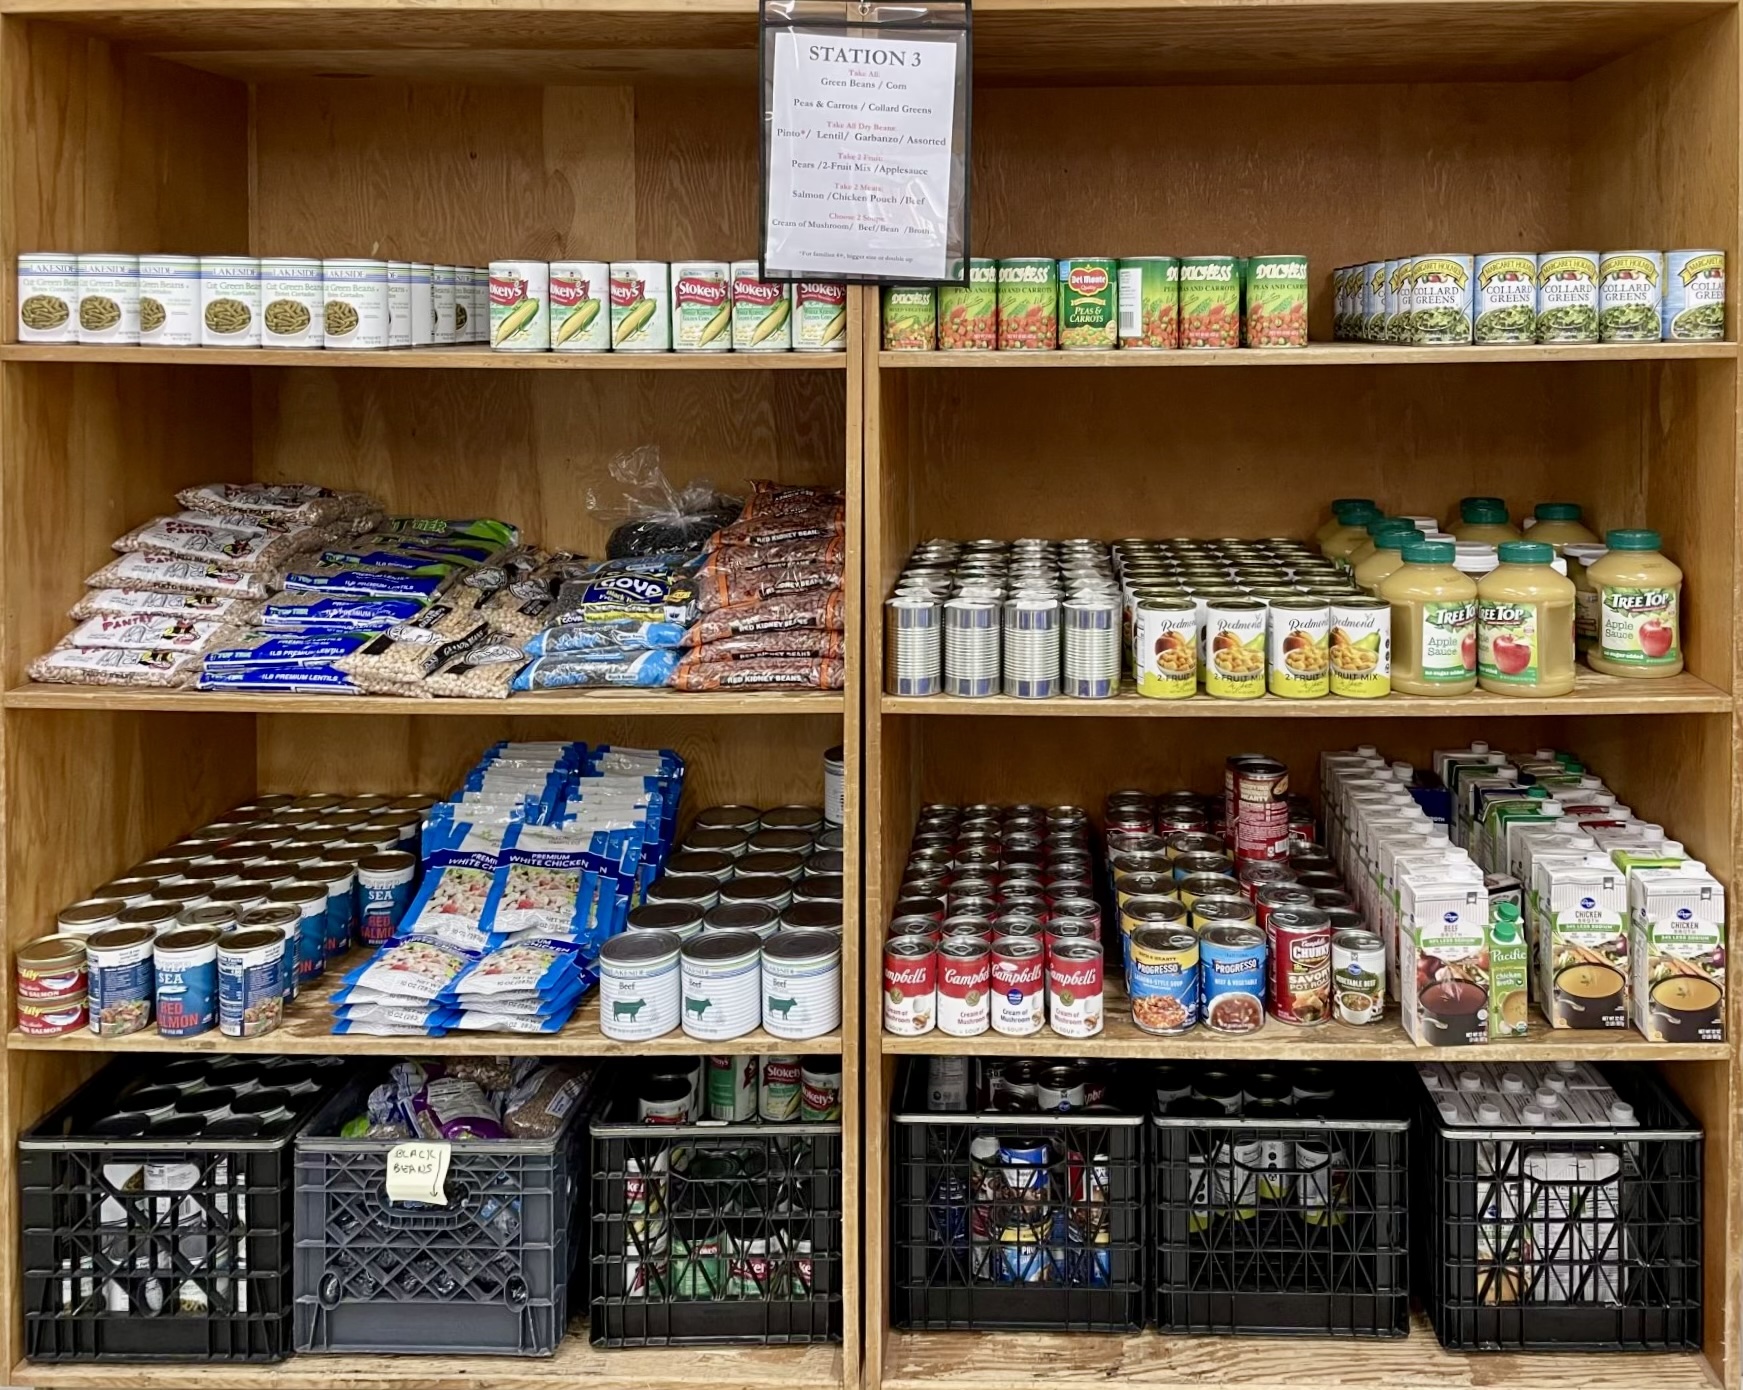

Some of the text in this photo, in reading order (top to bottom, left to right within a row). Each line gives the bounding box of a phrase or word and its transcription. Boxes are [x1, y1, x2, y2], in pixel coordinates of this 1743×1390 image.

[809, 45, 921, 68] STATION 3
[821, 77, 846, 87] Green
[849, 78, 875, 89] Beans
[886, 81, 907, 90] Corn
[794, 98, 813, 107] Peas
[816, 99, 824, 108] &
[826, 101, 858, 111] Carrots
[868, 102, 899, 113] Collard
[902, 105, 932, 115] Greens
[907, 135, 946, 146] Assorted
[791, 160, 815, 169] Pears
[854, 162, 872, 172] Mix
[792, 190, 825, 200] Salmon
[870, 193, 897, 204] Pouch
[772, 218, 797, 228] Cream
[799, 218, 807, 228] of
[1070, 275, 1106, 284] Del Monte
[1485, 285, 1534, 296] COLLARD
[1543, 284, 1592, 295] COLLARD
[1601, 283, 1651, 294] COLLARD
[1416, 296, 1456, 305] GREENS
[1489, 295, 1531, 304] GREENS
[1548, 294, 1590, 304] GREENS
[1605, 292, 1647, 302] GREENS
[1074, 306, 1102, 316] PEAS &
[1068, 313, 1104, 323] CARROTS
[601, 577, 663, 598] GOYA
[1611, 591, 1669, 609] TREE TOP
[1437, 608, 1465, 625] TREE
[1497, 606, 1524, 621] TOP
[102, 615, 153, 632] PANTRY
[1605, 620, 1634, 632] Apple
[1605, 629, 1634, 639] Sauce
[1428, 637, 1458, 649] Apple
[1427, 646, 1457, 656] Sauce
[1360, 673, 1378, 682] MIX
[448, 857, 478, 868] WHITE
[509, 855, 590, 870] WHITE CHICKEN
[531, 852, 571, 862] PREMIUM
[368, 890, 393, 900] SEA
[1575, 910, 1602, 919] CHICKEN
[1670, 921, 1699, 930] CHICKEN
[1492, 949, 1527, 963] Pacific
[1136, 962, 1179, 975] PROGRESSO
[1214, 959, 1257, 974] PROGRESSO
[158, 973, 185, 984] SEA
[773, 978, 788, 988] Beef
[619, 981, 636, 991] Beef
[1289, 983, 1310, 993] POT
[160, 1002, 184, 1015] RED
[394, 1149, 437, 1160] BLACK
[392, 1163, 433, 1175] BEANS
